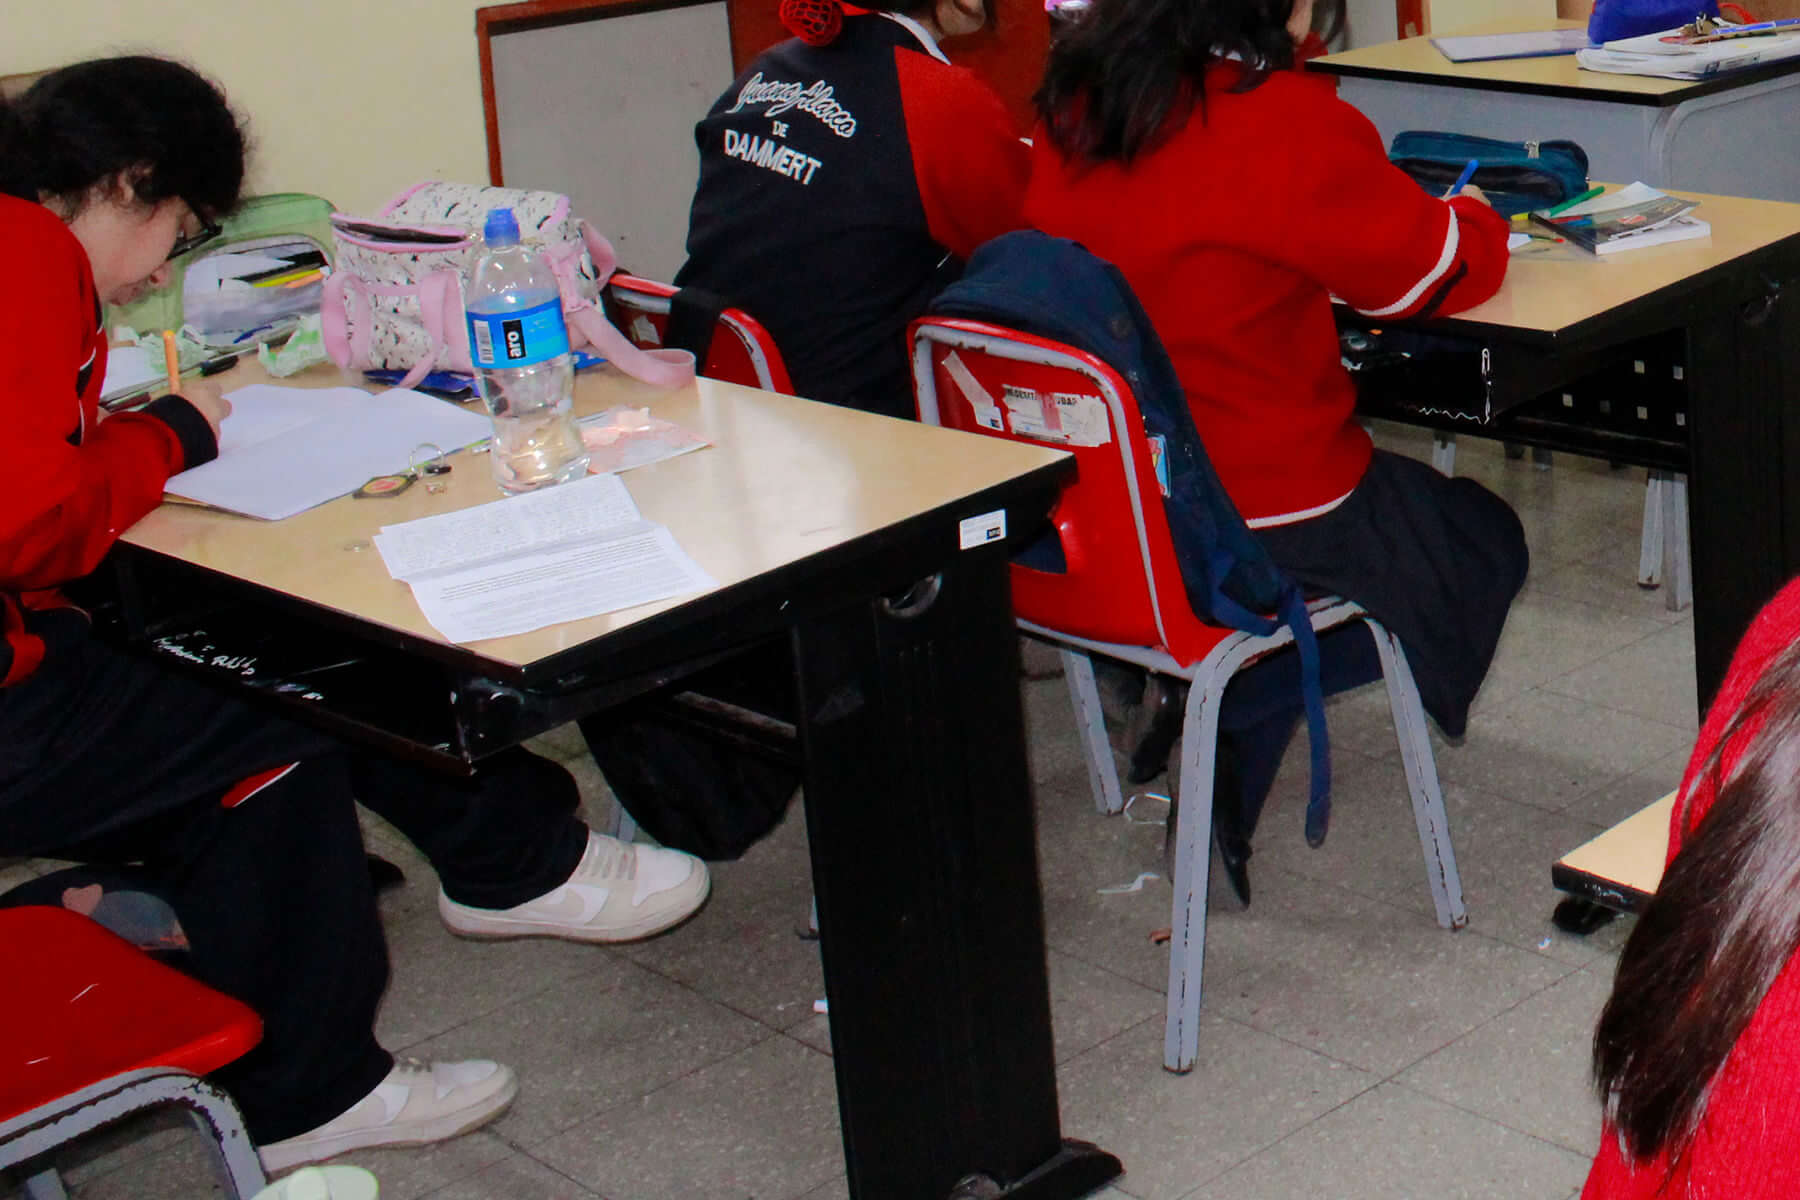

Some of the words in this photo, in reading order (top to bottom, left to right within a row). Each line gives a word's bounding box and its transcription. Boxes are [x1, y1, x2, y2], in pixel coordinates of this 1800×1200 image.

[773, 120, 790, 139] DE
[723, 129, 824, 185] DAMMERT
[506, 330, 522, 358] aro
